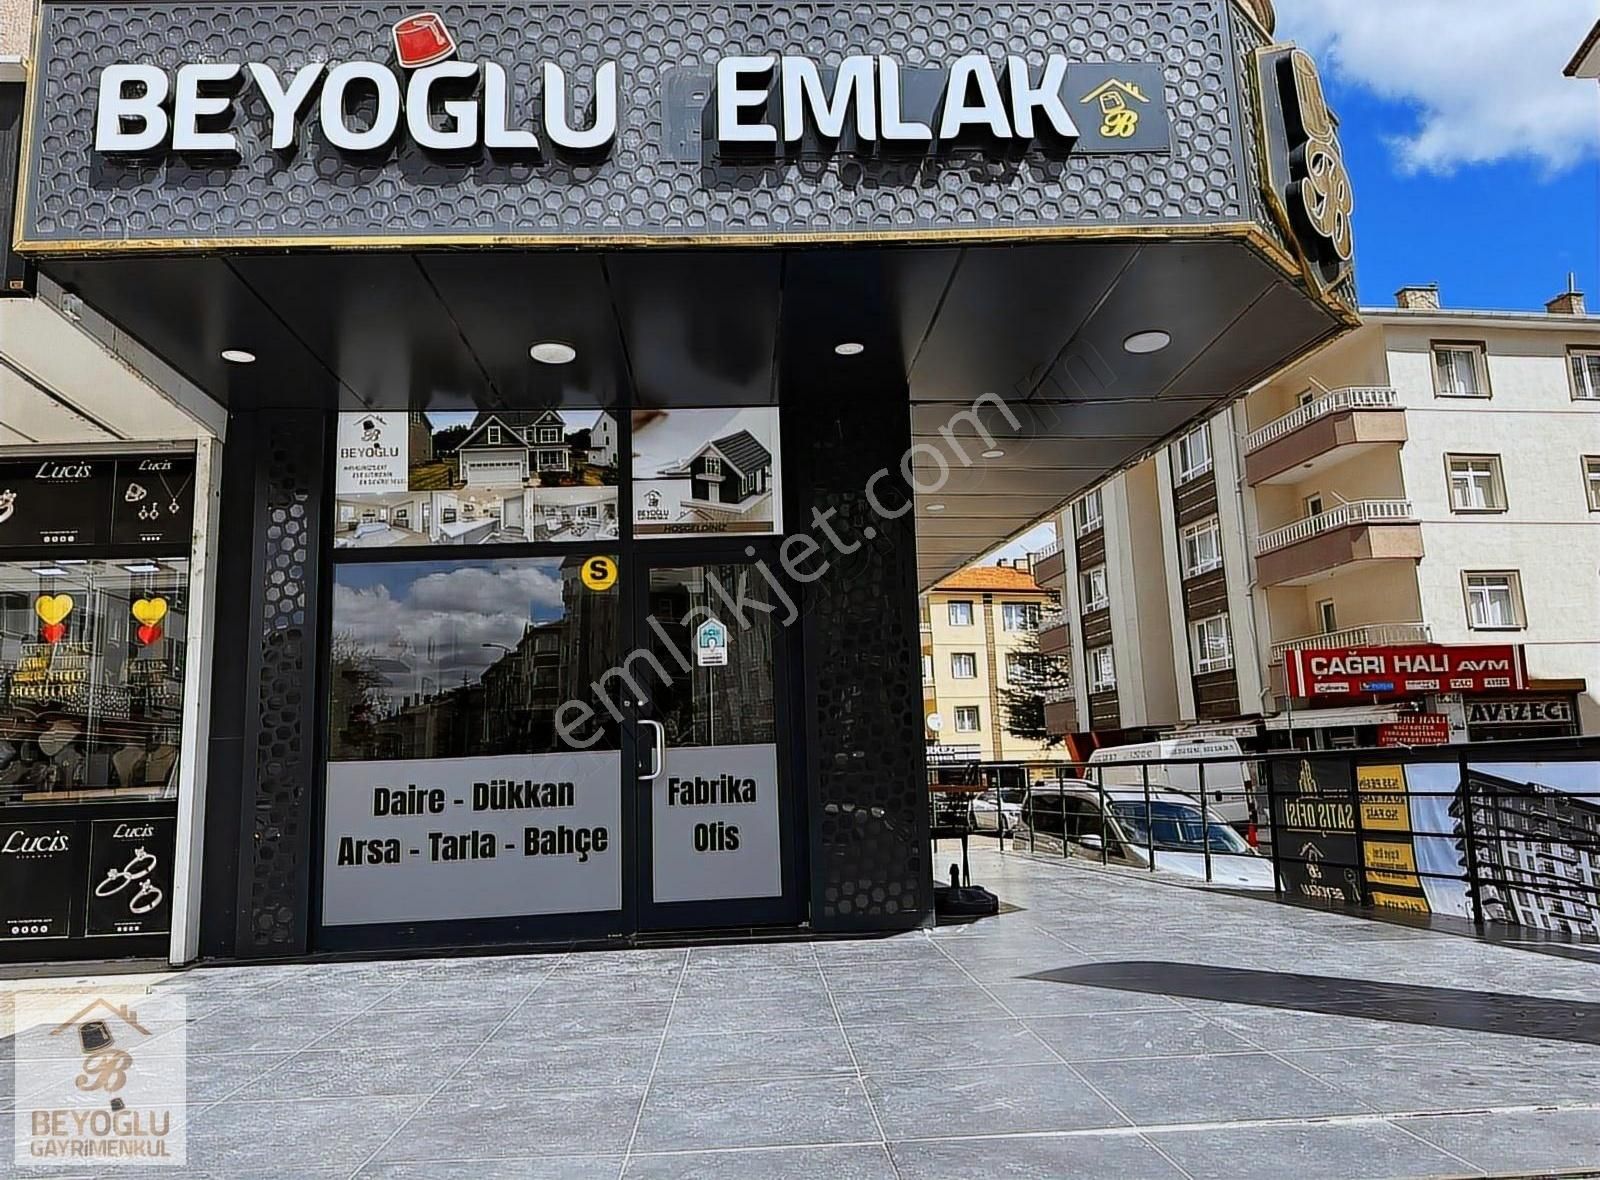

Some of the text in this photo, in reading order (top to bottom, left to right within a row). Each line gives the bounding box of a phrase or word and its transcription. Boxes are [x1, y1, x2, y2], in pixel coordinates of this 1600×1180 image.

[716, 55, 1080, 142] EMLAK
[36, 461, 92, 479] Lucis
[139, 460, 172, 471] Lucis
[1311, 651, 1509, 680] ÇAĞRI HALI AVM
[373, 786, 445, 816] Daire
[473, 780, 576, 813] Dükkan
[667, 774, 757, 806] Fabrika
[3, 829, 70, 853] Lucis
[112, 823, 155, 838] Lucis
[338, 835, 402, 866] Arsa
[428, 830, 497, 862] Tarla
[523, 825, 609, 863] Bahçe
[693, 820, 740, 853] Ofis
